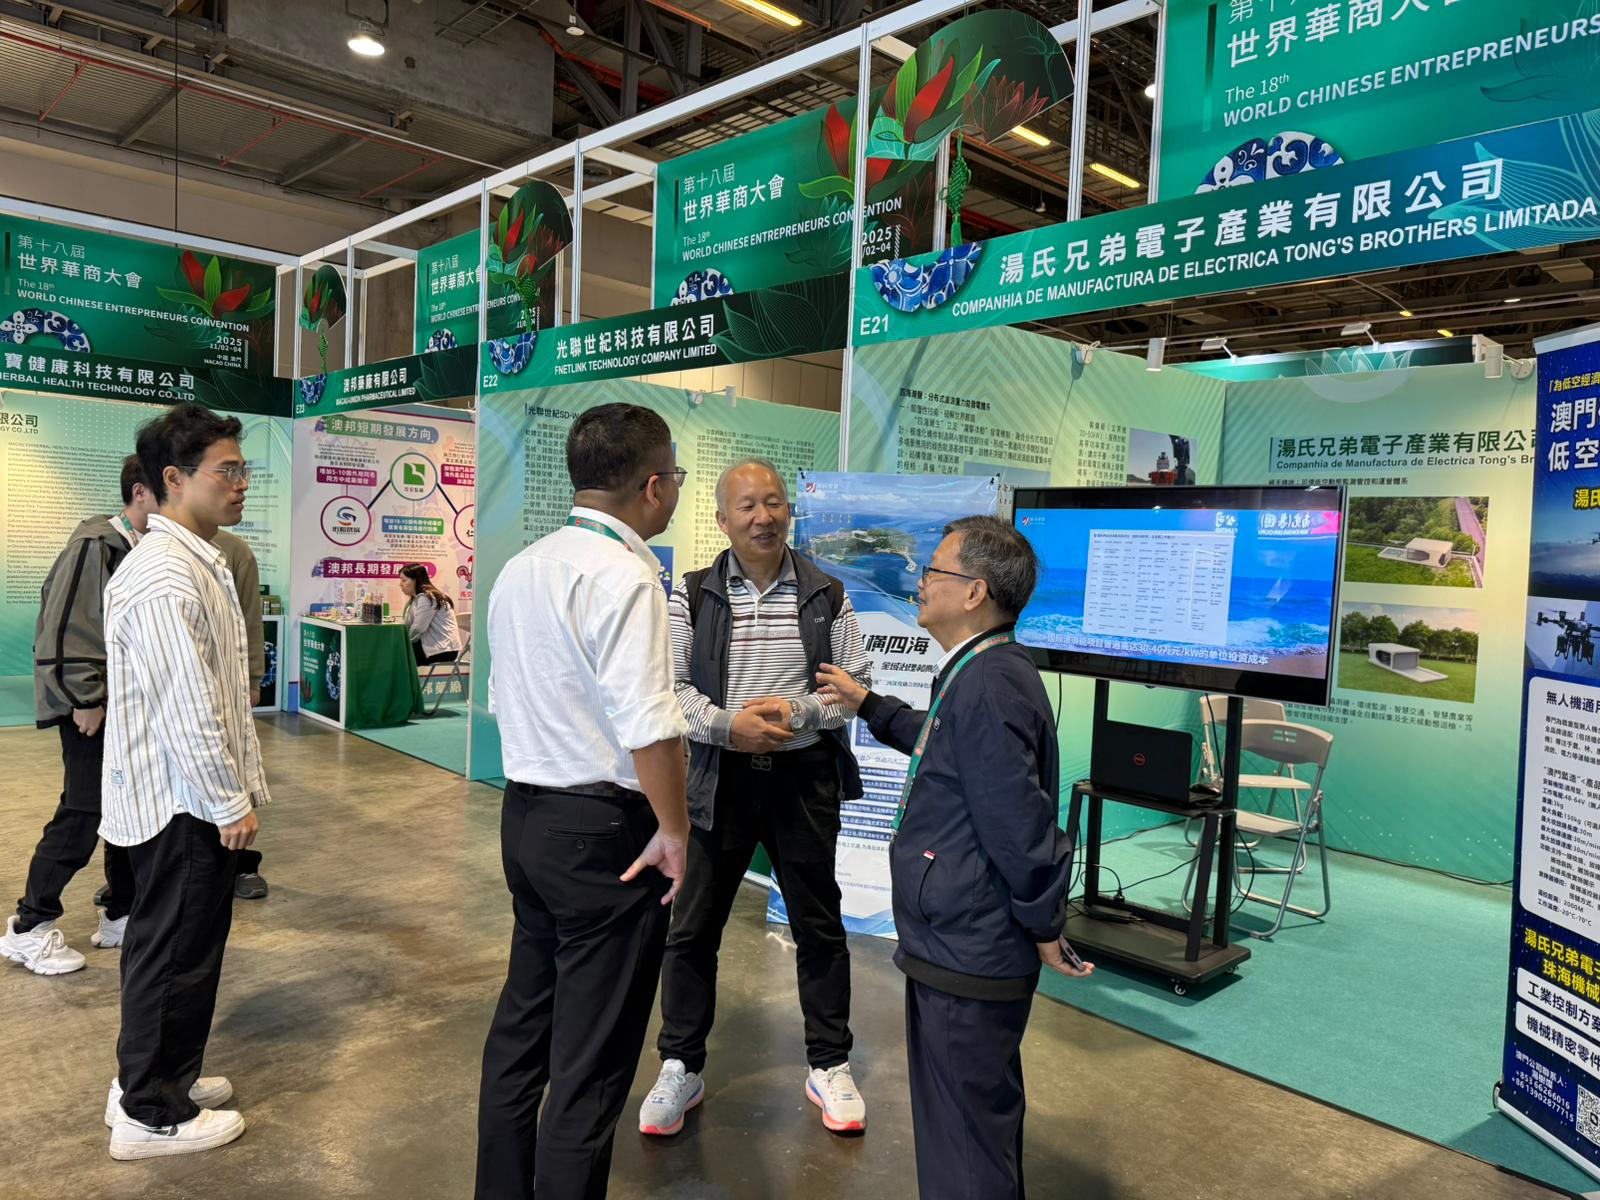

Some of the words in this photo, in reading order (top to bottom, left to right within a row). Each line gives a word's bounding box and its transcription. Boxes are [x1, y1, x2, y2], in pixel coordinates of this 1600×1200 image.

[1227, 0, 1463, 68] 世界華商大
[1223, 96, 1292, 128] WORLD
[1297, 71, 1386, 109] CHINESE
[1390, 15, 1600, 86] ENTREPRENEURS
[1224, 84, 1255, 105] The
[1260, 73, 1290, 96] 18th
[684, 163, 735, 195] 第十八屆
[683, 174, 785, 224] 世界華商大會
[682, 246, 711, 262] WORLD
[712, 237, 749, 255] CHINESE
[750, 217, 830, 246] ENTREPRENEURS
[832, 197, 902, 226] CONENTION
[861, 226, 892, 246] 2025
[999, 158, 1503, 286] 湯氏兄弟電子產業有限公司
[17, 234, 86, 260] 第十八屆
[683, 236, 697, 247] The
[952, 290, 1022, 318] COMPANHIA
[1025, 287, 1043, 304] DE
[1047, 271, 1155, 301] MANUFACTURA
[1157, 266, 1180, 283] DE
[1184, 250, 1279, 279] ELECTRICA
[1283, 236, 1353, 263] TONG'S
[1359, 216, 1477, 252] BROTHERS
[1485, 197, 1597, 233] LIMITADA
[17, 252, 143, 289] 世界華商大會
[18, 278, 36, 289] The
[17, 289, 56, 303] WORLD
[59, 295, 104, 310] CHINESE
[105, 303, 189, 323] ENTREPRENEURS
[190, 316, 250, 333] CONVENTION
[431, 312, 447, 324] WORLD
[447, 307, 466, 320] CHINESE
[860, 314, 889, 336] E21
[216, 335, 242, 347] 2025
[556, 314, 715, 360] 光聯世紀科技有限公司
[4, 352, 195, 390] 寶健康科技有限公司
[554, 361, 588, 375] FNETLINK
[588, 354, 639, 370] TECHNOLOGY
[641, 349, 682, 364] COMPANY
[683, 343, 717, 359] LIMITED
[42, 376, 84, 389] HEALTH
[86, 381, 156, 398] TECHNOLOGY
[158, 389, 195, 401] CO.,LTD
[398, 387, 416, 397] LIMITED
[483, 375, 499, 388] E22
[296, 404, 305, 414] E23
[1550, 397, 1600, 433] 澳門
[332, 418, 432, 441] 澳邦短期發展方向
[1277, 460, 1328, 470] Companhia
[1331, 460, 1343, 468] de
[1346, 457, 1408, 467] Manufactura
[1411, 457, 1423, 466] de
[1427, 456, 1475, 466] Electrica
[1478, 455, 1516, 466] Tong's
[1548, 437, 1600, 472] 低空
[1511, 1077, 1525, 1089] +86
[1526, 1085, 1575, 1122] 13902877715
[1516, 1070, 1533, 1085] +853
[1533, 1081, 1570, 1111] 66266016
